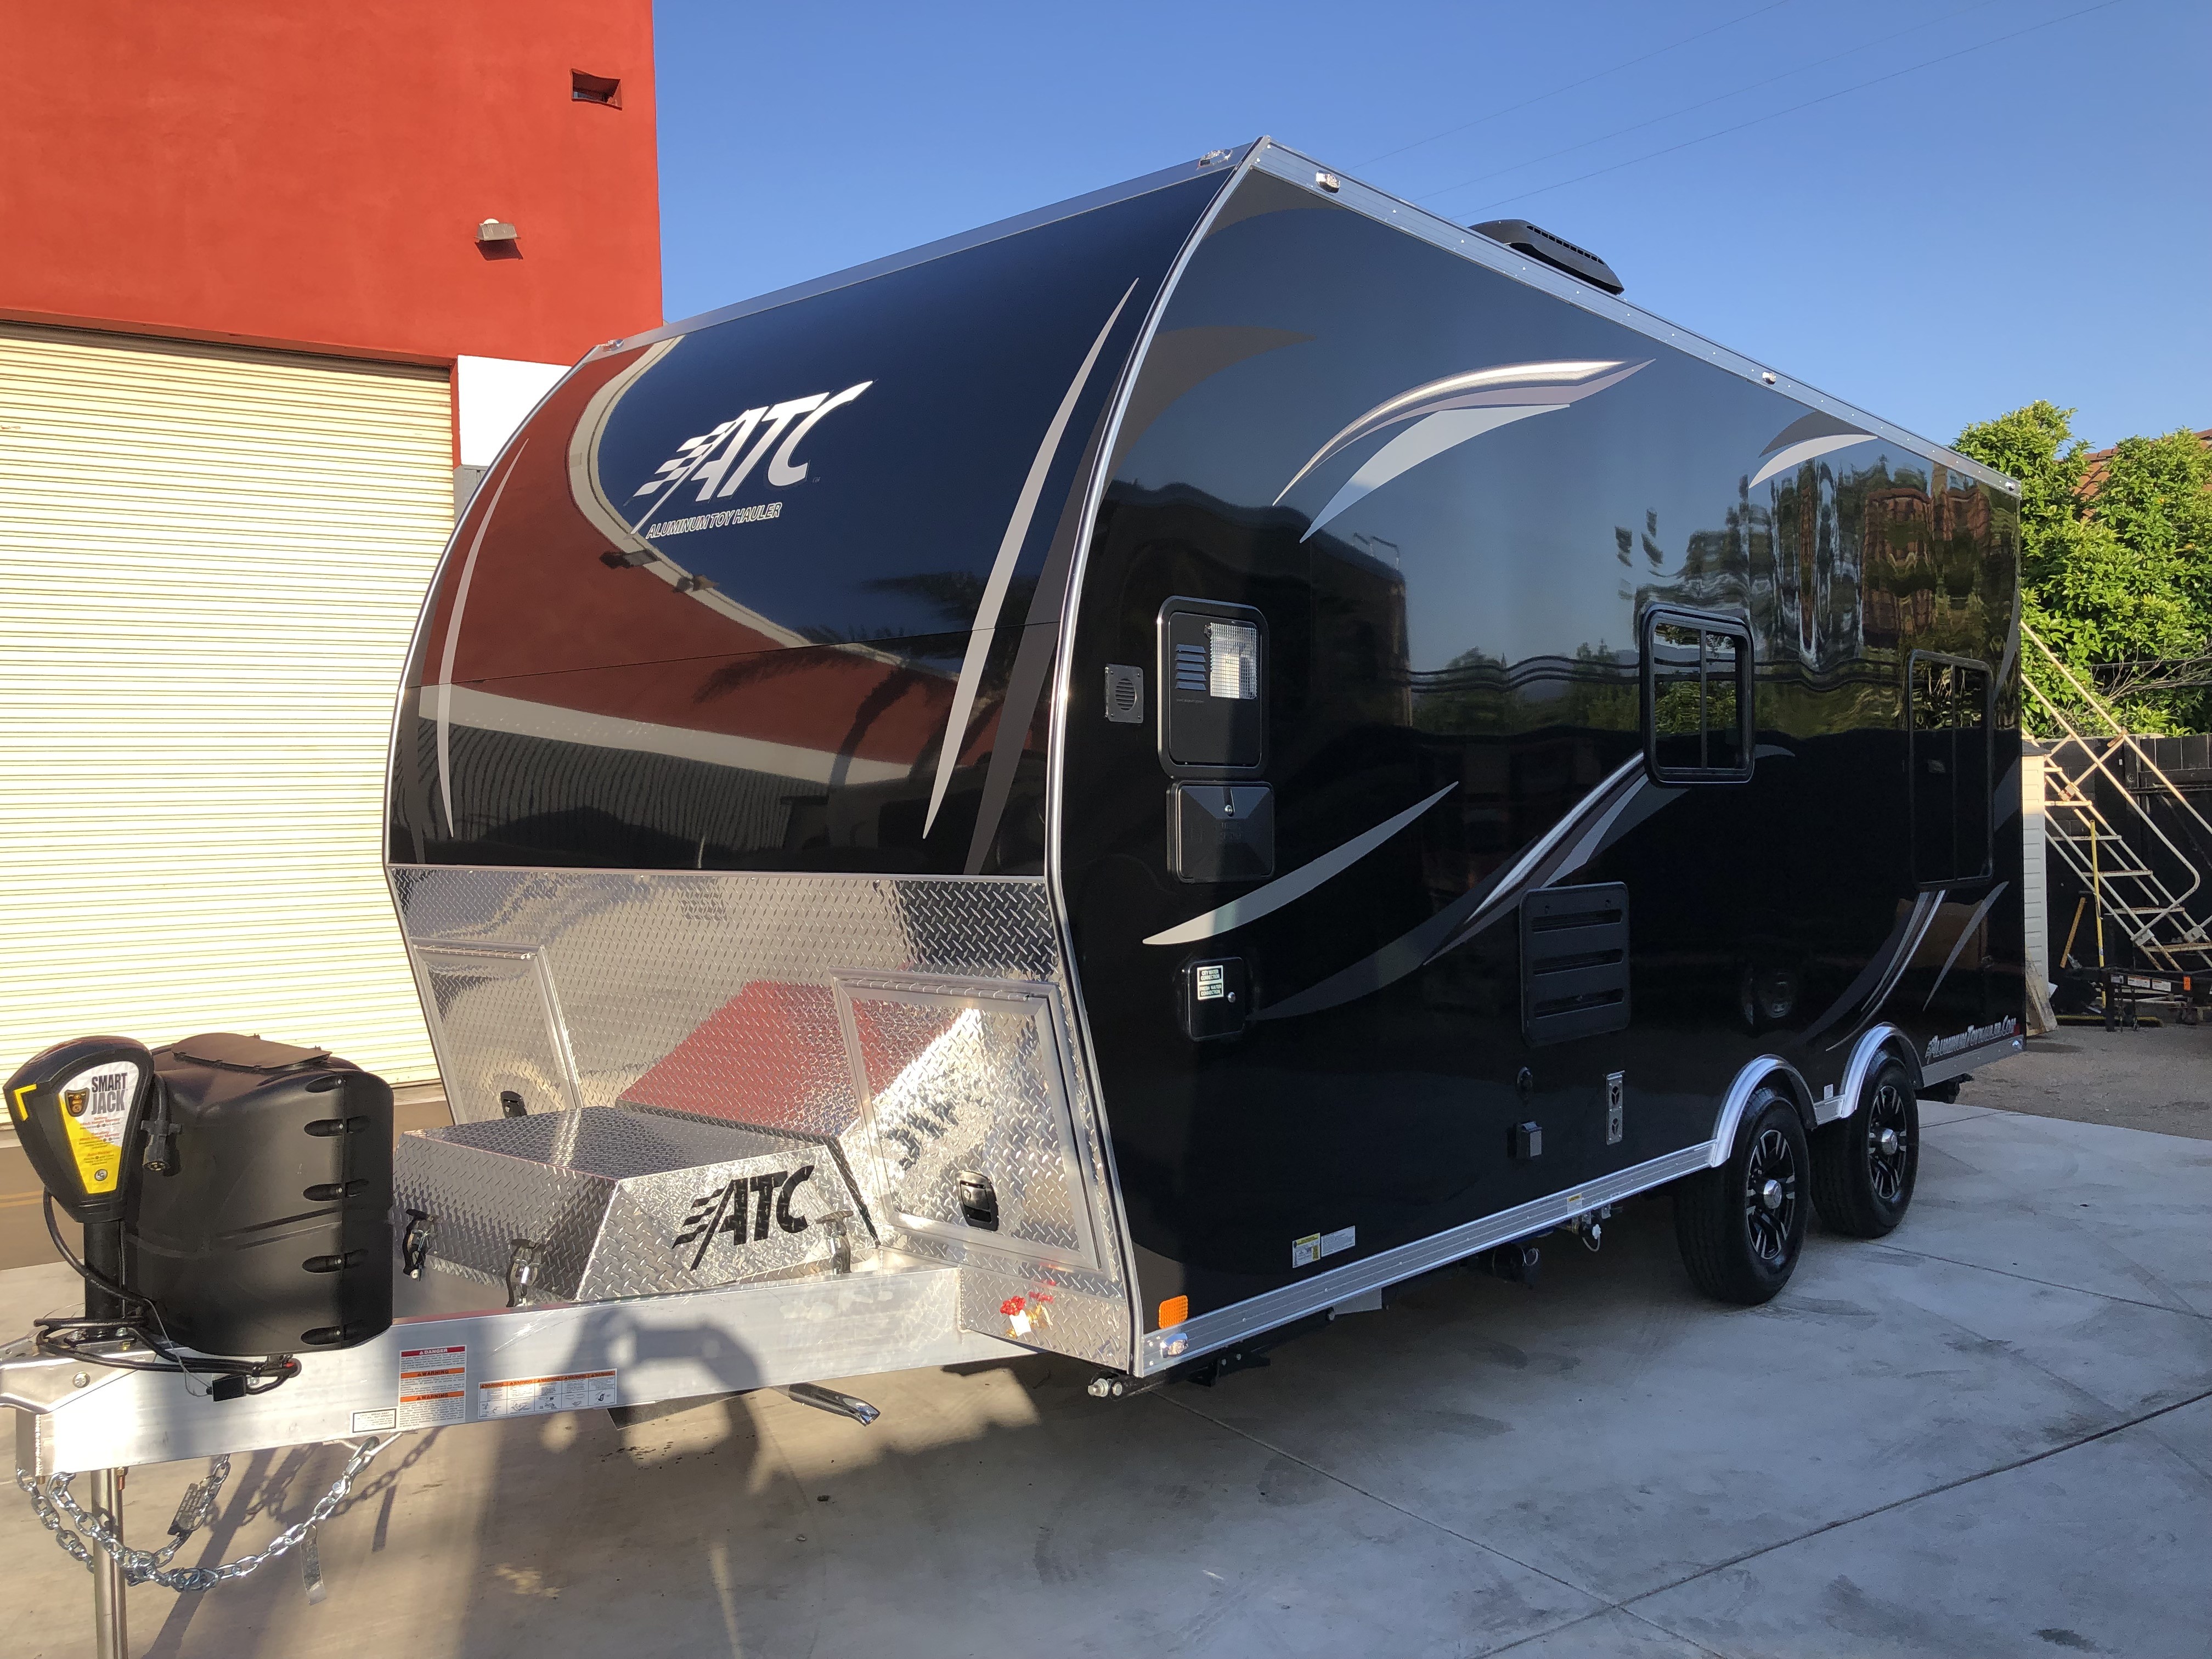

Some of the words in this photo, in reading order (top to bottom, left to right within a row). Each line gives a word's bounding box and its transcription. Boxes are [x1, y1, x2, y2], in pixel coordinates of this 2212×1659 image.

[631, 381, 873, 534] ATC
[645, 514, 710, 539] ALUMINUM
[709, 510, 736, 529] TOY
[732, 501, 783, 524] HAULER
[91, 1072, 128, 1093] SMART
[91, 1089, 125, 1115] JACK
[672, 1165, 815, 1272] ATC
